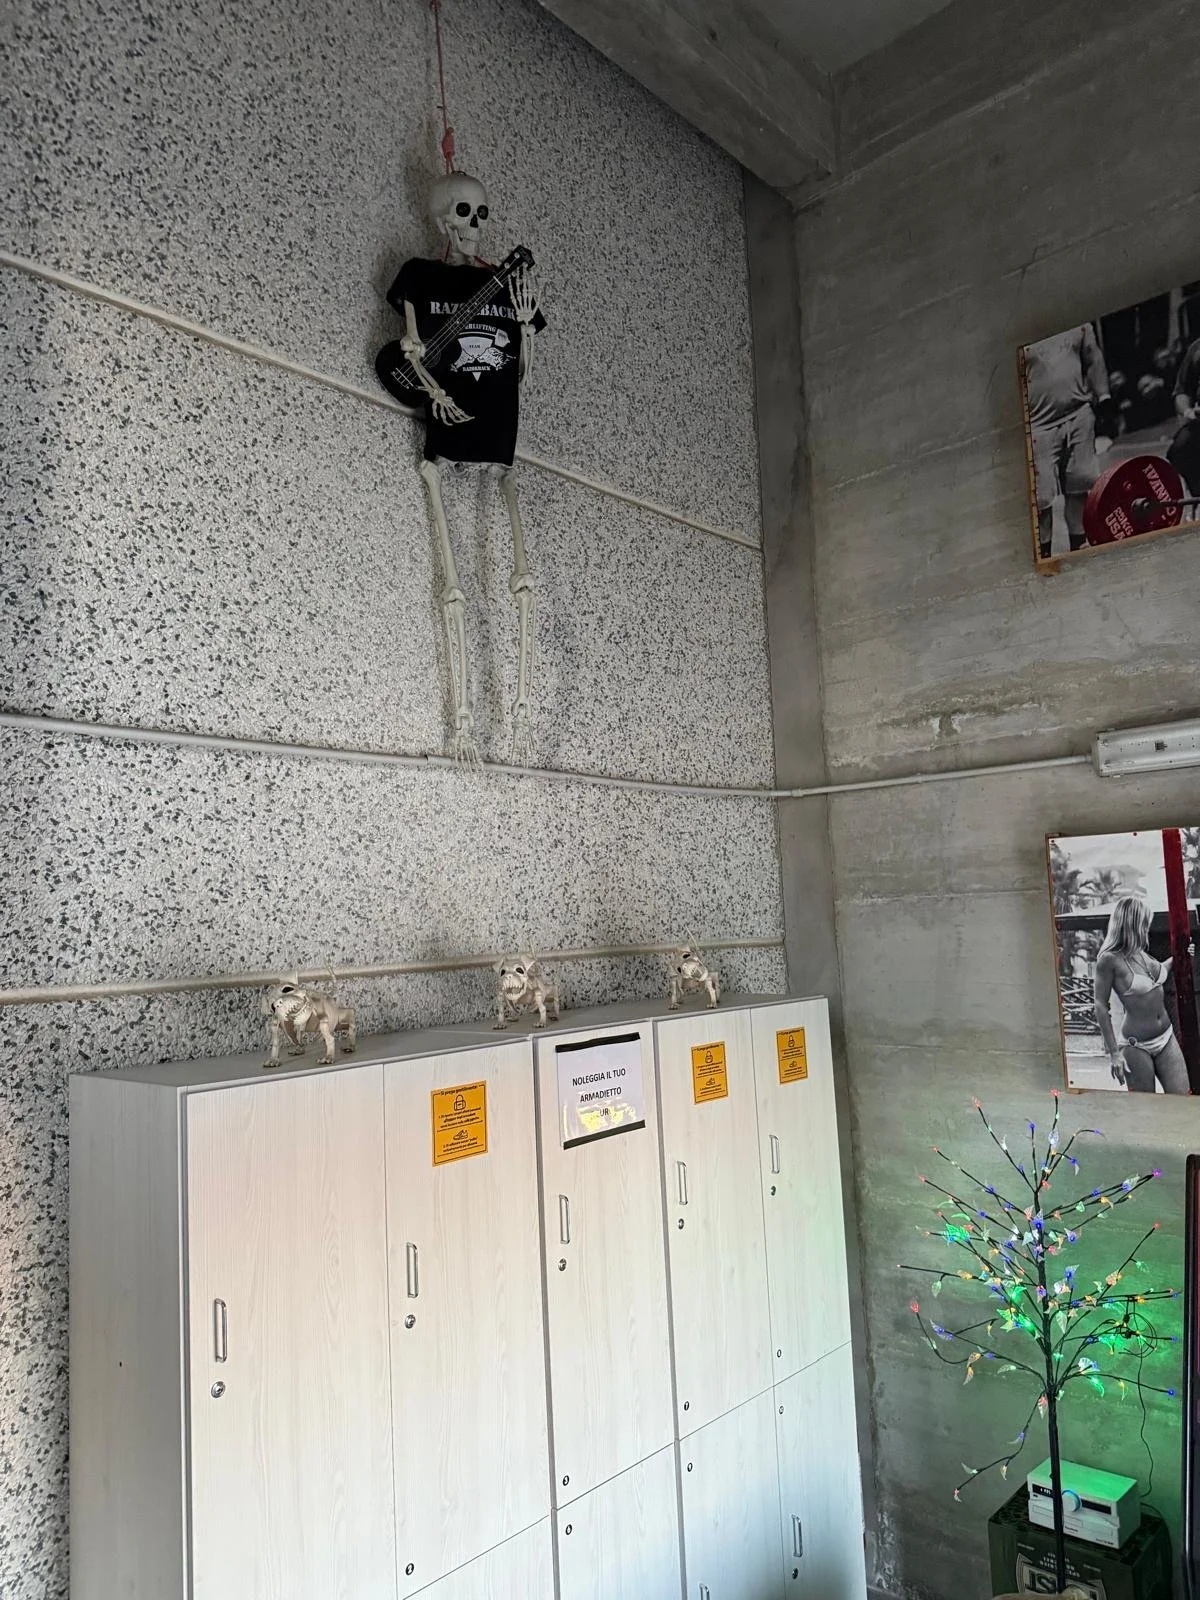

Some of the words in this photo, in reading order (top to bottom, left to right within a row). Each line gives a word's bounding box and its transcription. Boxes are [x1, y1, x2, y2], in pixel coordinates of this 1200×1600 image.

[430, 301, 516, 320] RAZBACK
[572, 1072, 605, 1087] NOLEGGIA
[606, 1071, 612, 1080] IL
[613, 1068, 626, 1078] TUO
[580, 1086, 622, 1103] ARMADIETTO
